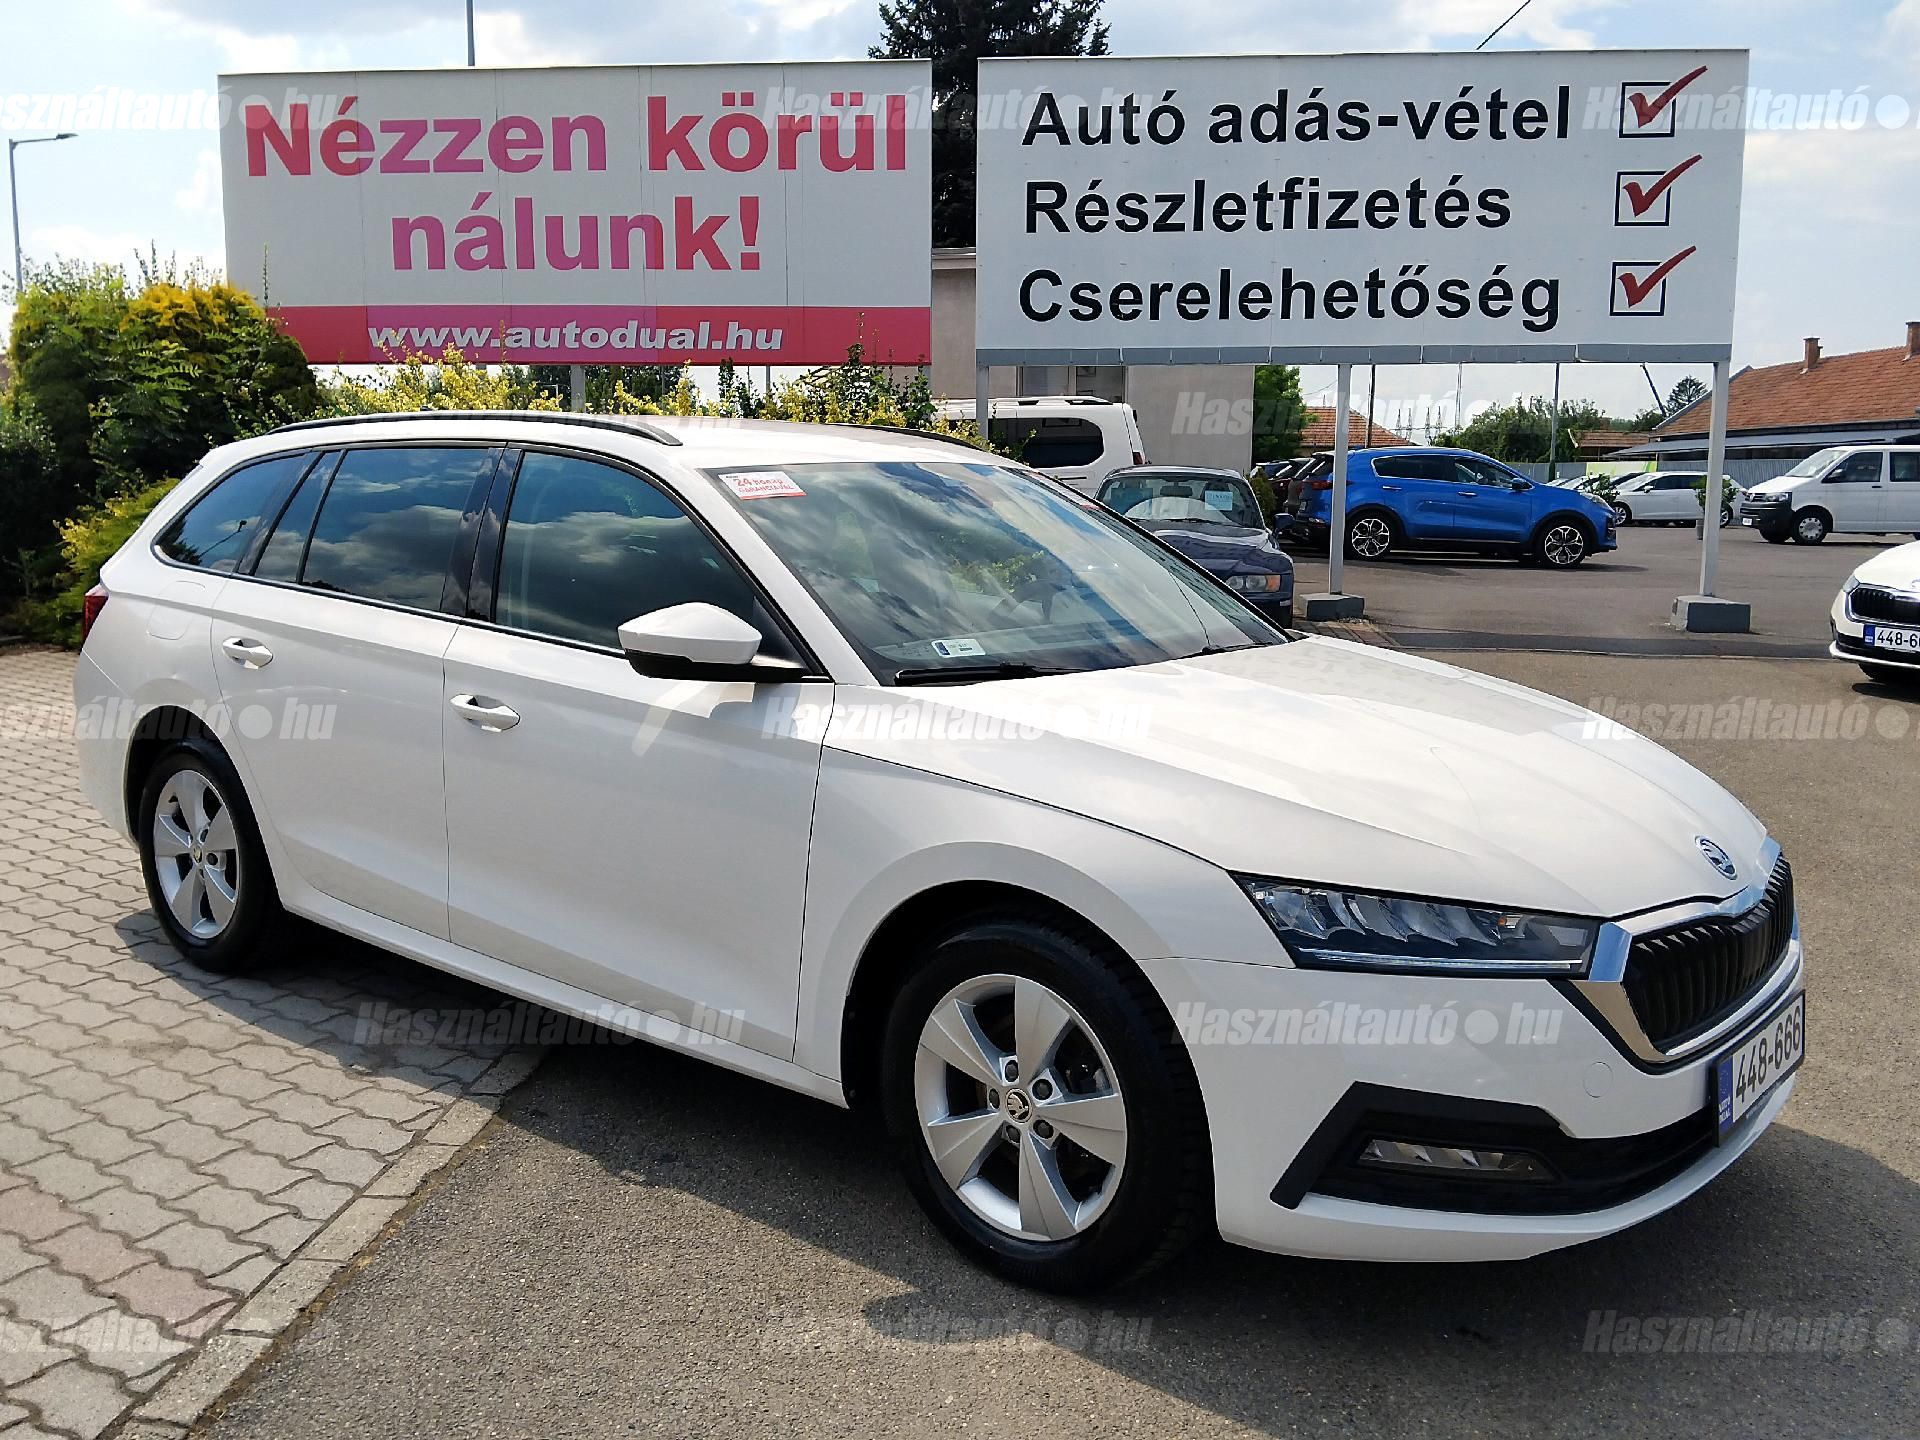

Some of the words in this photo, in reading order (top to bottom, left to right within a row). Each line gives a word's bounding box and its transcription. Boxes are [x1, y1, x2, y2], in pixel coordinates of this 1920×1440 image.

[247, 97, 605, 176] Nézzen
[649, 93, 905, 171] körül
[1022, 89, 1186, 146] Autó
[1208, 86, 1570, 143] adás-vétel
[394, 193, 759, 270] nálunk!
[1026, 174, 1511, 233] Részletfizetés
[1019, 264, 1559, 332] Cserelehetőség
[369, 320, 782, 350] www.autodual.hu
[1877, 630, 1920, 648] 448-6
[1736, 1005, 1801, 1103] 448-666
